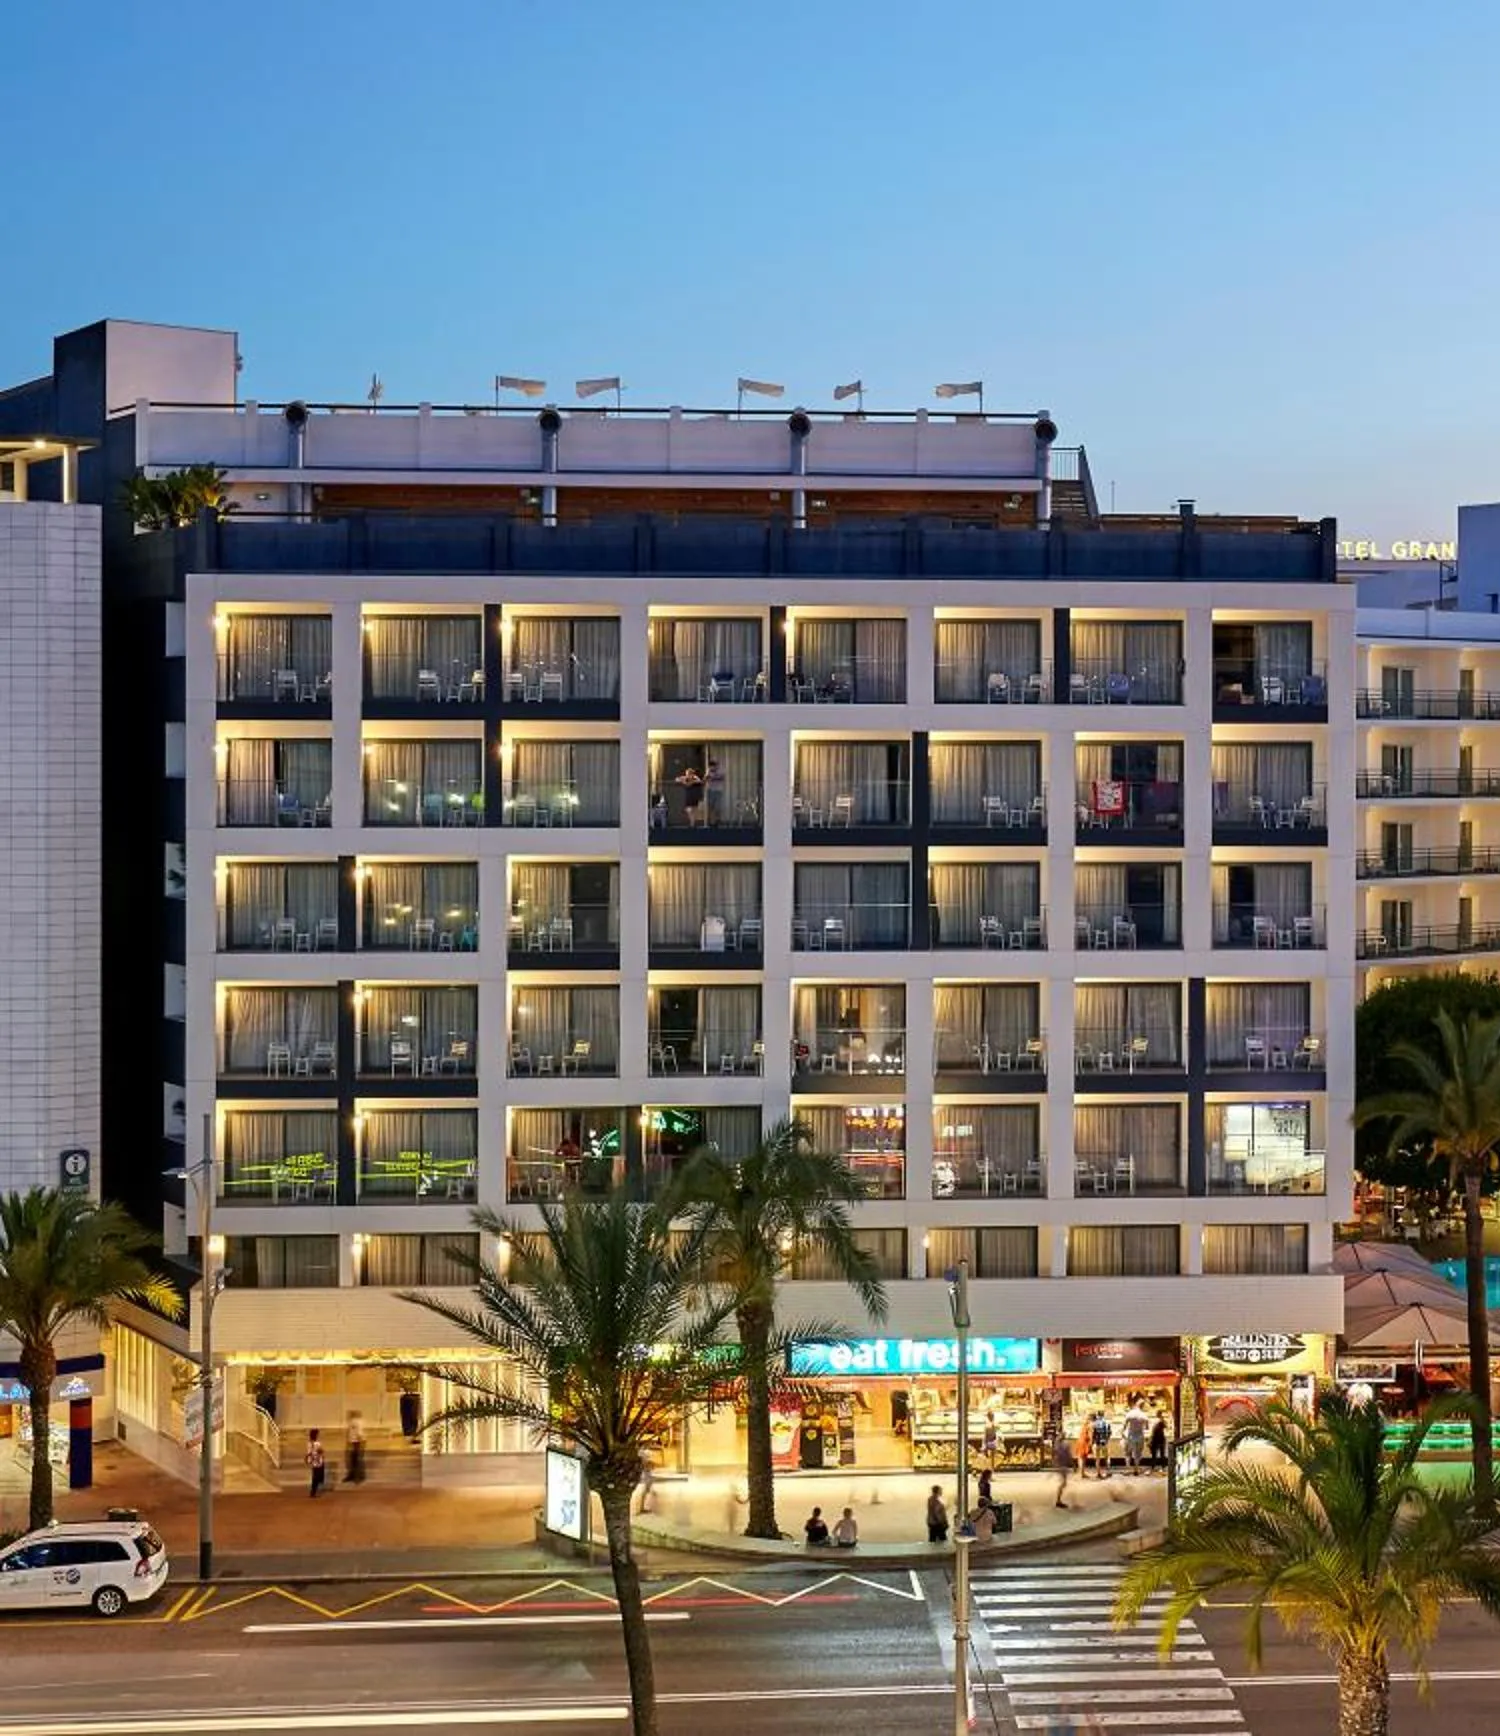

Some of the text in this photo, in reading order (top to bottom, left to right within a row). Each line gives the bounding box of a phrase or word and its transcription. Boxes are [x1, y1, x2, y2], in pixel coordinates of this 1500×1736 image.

[1336, 541, 1456, 558] TEL GRAN
[828, 1339, 888, 1369] eat
